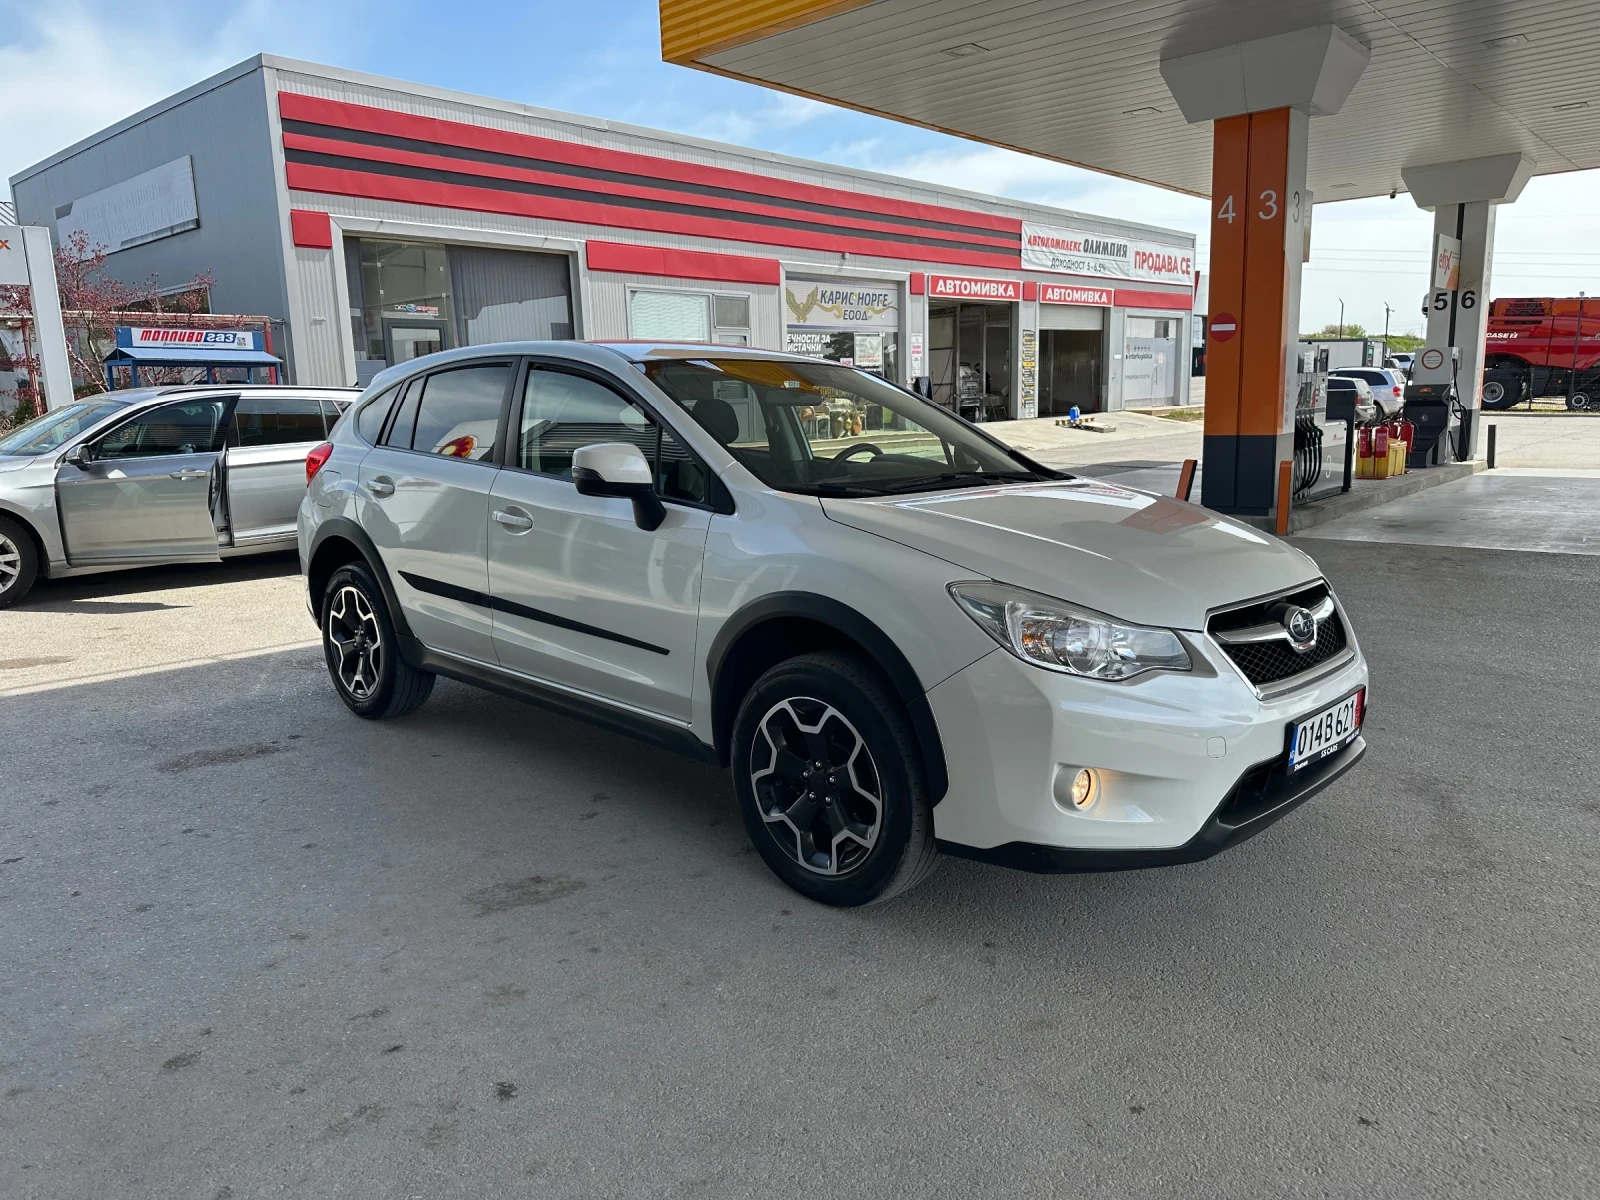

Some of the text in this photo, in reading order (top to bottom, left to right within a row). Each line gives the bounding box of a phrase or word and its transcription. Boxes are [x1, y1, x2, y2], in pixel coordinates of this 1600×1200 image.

[1217, 195, 1236, 224] 4
[1258, 190, 1278, 220] 3
[1292, 190, 1300, 223] 3
[1027, 234, 1128, 258] АВТОКОМПЛЕКС ОЛИМПИЯ
[1051, 258, 1085, 270] ДОХОДНОСТ
[1134, 251, 1191, 275] ПРОДАВА СЕ
[936, 279, 1015, 297] АВТОМИВКА
[1046, 288, 1108, 303] АВТОМИВКА
[820, 290, 889, 307] КАРИС НОРГЕ
[1433, 293, 1448, 311] 5
[1461, 290, 1476, 309] 6
[843, 309, 868, 320] ЕООД
[787, 334, 831, 343] ЕЧНОСТИ ЗА
[787, 343, 822, 352] ИСТАЧКИ
[1325, 455, 1332, 478] 3
